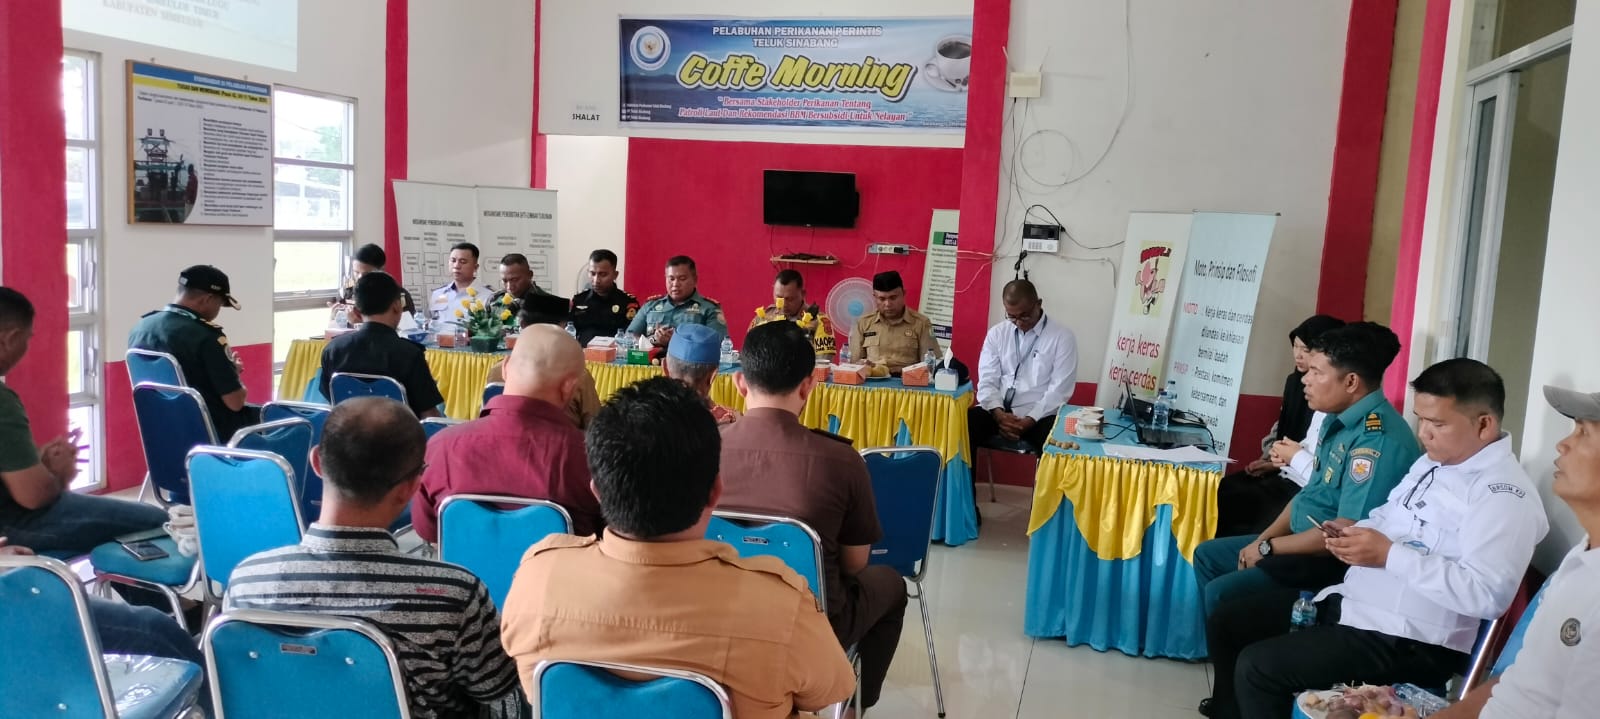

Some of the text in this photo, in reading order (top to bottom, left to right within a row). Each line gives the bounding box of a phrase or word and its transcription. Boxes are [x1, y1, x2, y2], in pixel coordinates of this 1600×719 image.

[712, 27, 883, 36] PELABUHAN PERIKANAN PERINTIS
[753, 38, 839, 48] TELUK SINABANG
[679, 54, 913, 98] Coffe Morning
[756, 96, 801, 108] Stakeholder
[802, 98, 839, 108] Perikanan
[841, 99, 872, 109] Tentang
[679, 107, 703, 117] Patroli
[704, 107, 721, 118] Laut
[722, 108, 738, 118] Dan
[740, 108, 788, 119] Rekomendasi
[789, 110, 807, 120] BBM
[808, 109, 848, 120] Bersubsidi
[850, 111, 872, 121] Untuk
[1208, 260, 1225, 283] Prinsip
[1225, 266, 1236, 281] dan
[1236, 263, 1258, 283] Filosofi
[1117, 330, 1160, 358] kerja keras
[1109, 360, 1157, 391] kerja cerdas
